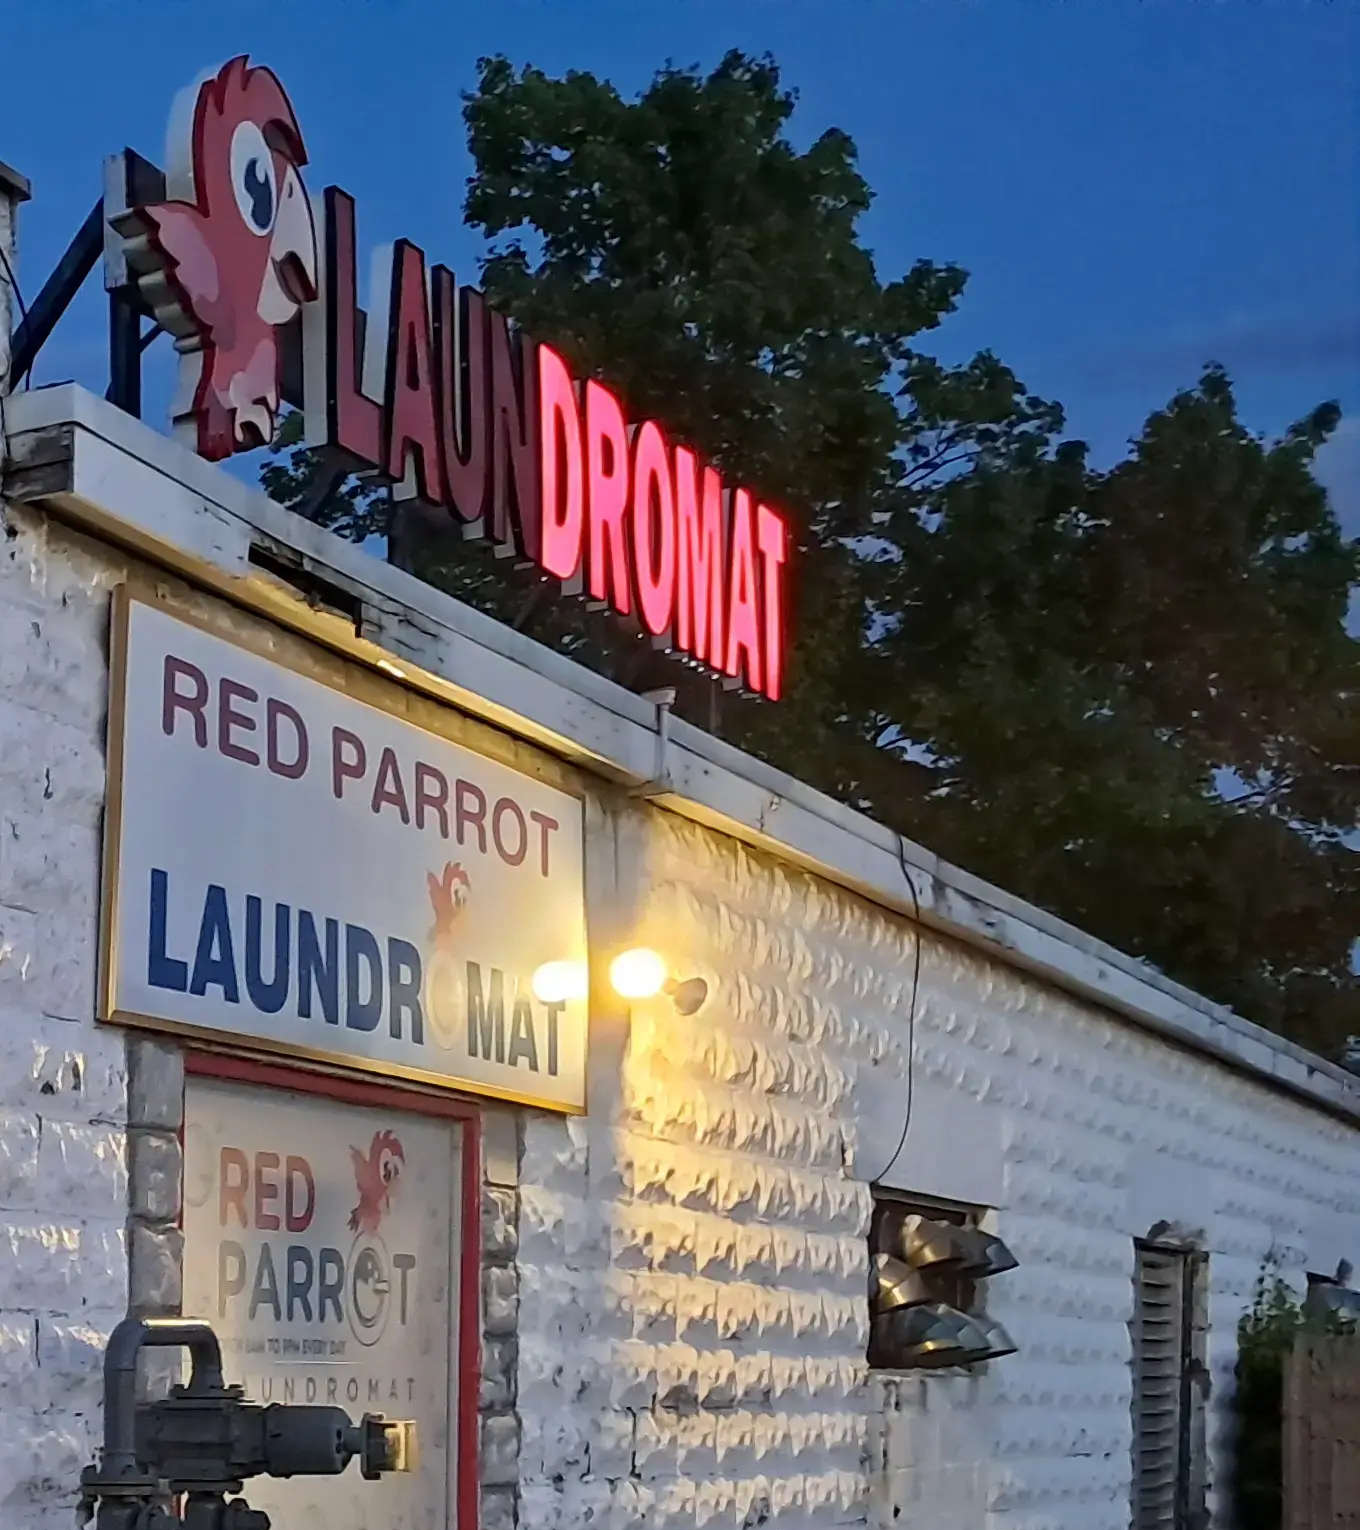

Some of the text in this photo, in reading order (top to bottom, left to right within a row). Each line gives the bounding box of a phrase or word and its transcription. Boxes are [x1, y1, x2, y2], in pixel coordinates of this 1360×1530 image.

[323, 184, 787, 701] LAUNDROMAT
[162, 654, 560, 878] RED PARROT
[219, 1145, 316, 1233] RED
[216, 1236, 417, 1344] PARROT
